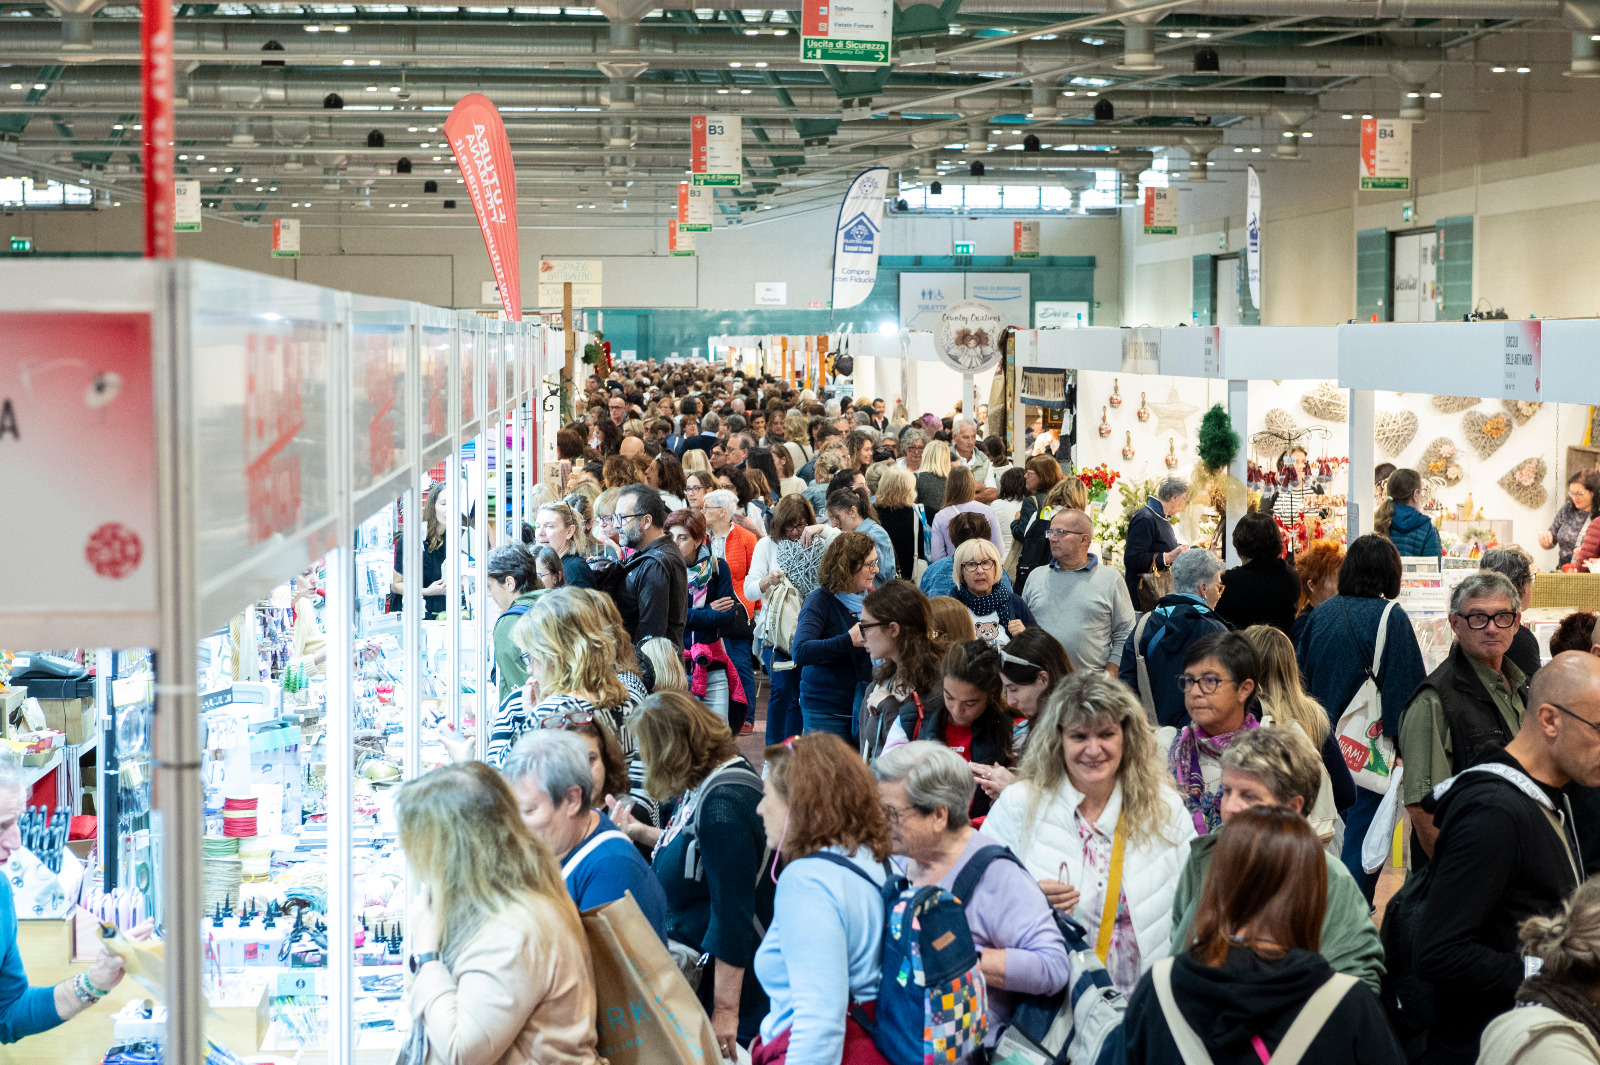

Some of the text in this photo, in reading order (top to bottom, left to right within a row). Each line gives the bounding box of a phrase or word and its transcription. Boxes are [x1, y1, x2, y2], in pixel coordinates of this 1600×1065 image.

[806, 40, 833, 48] Uscita
[845, 41, 885, 50] Sicurezza
[709, 125, 724, 135] B3
[1379, 129, 1394, 138] B4
[942, 314, 968, 324] Country
[1503, 768, 1526, 785] EA7
